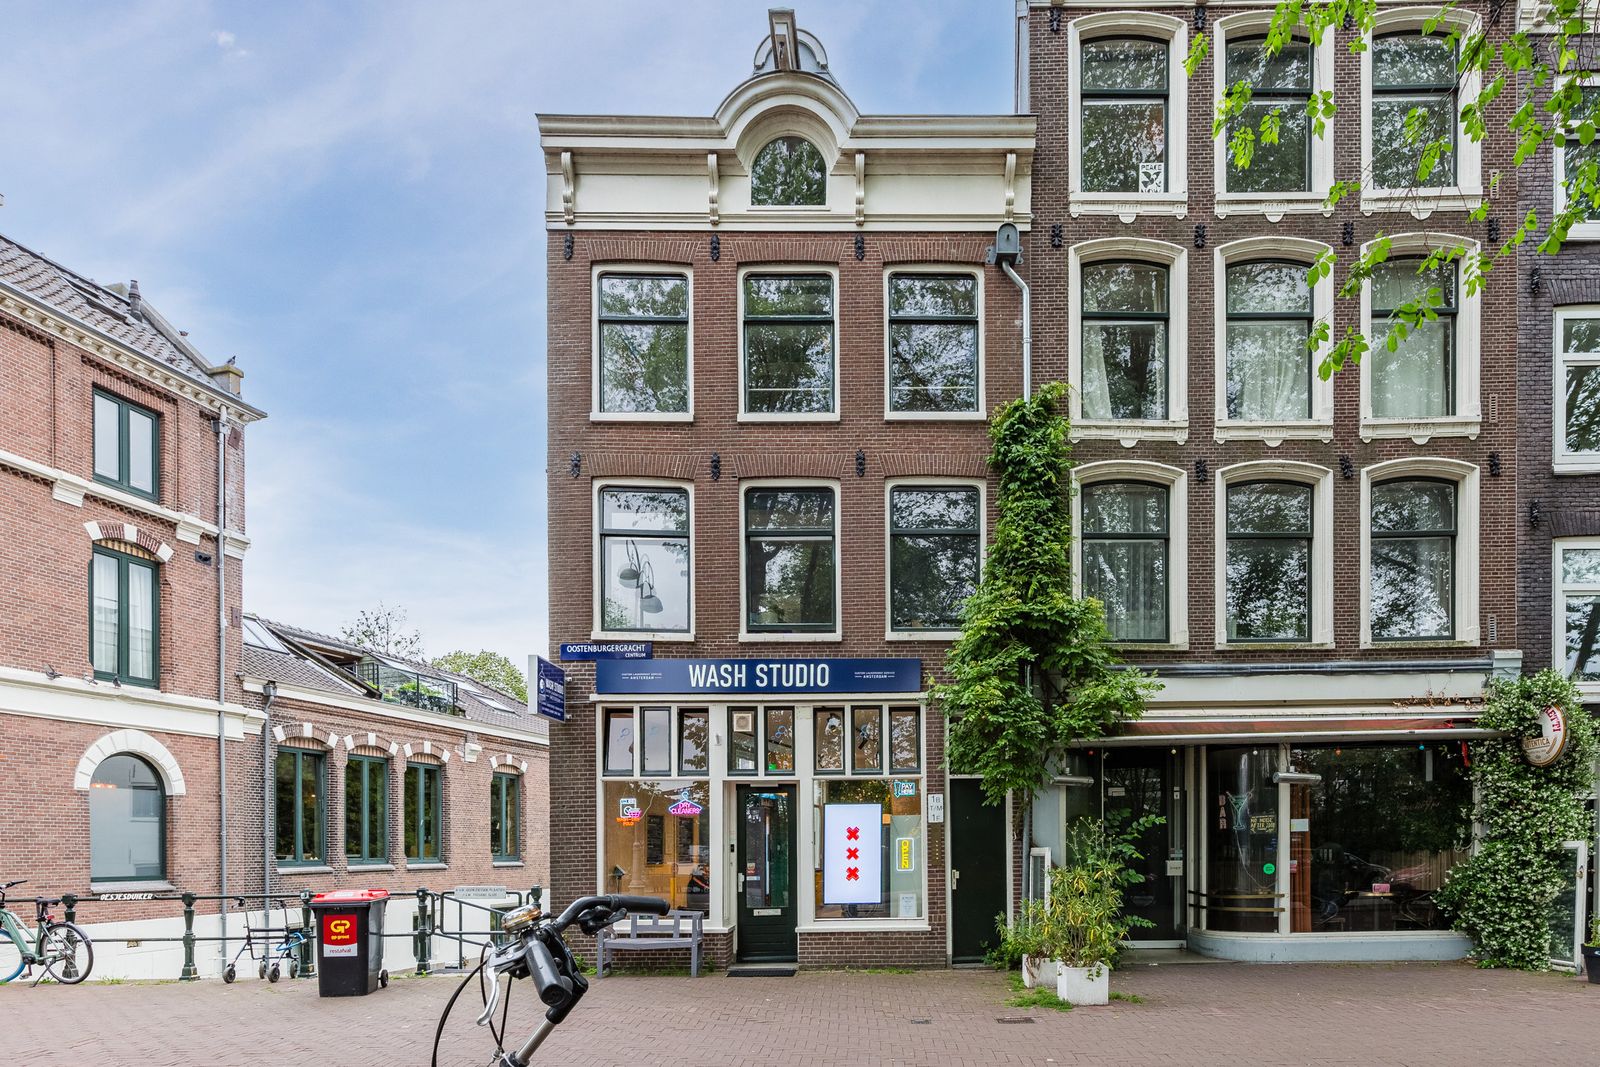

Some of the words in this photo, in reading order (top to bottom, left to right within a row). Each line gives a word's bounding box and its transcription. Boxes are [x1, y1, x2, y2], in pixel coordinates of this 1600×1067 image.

[566, 644, 646, 653] OOSTENBURGERGRACHT
[688, 664, 746, 687] WASH
[755, 664, 830, 687] STUDIO
[1219, 795, 1227, 829] BAR
[901, 840, 909, 869] OPEN
[330, 920, 350, 933] GP
